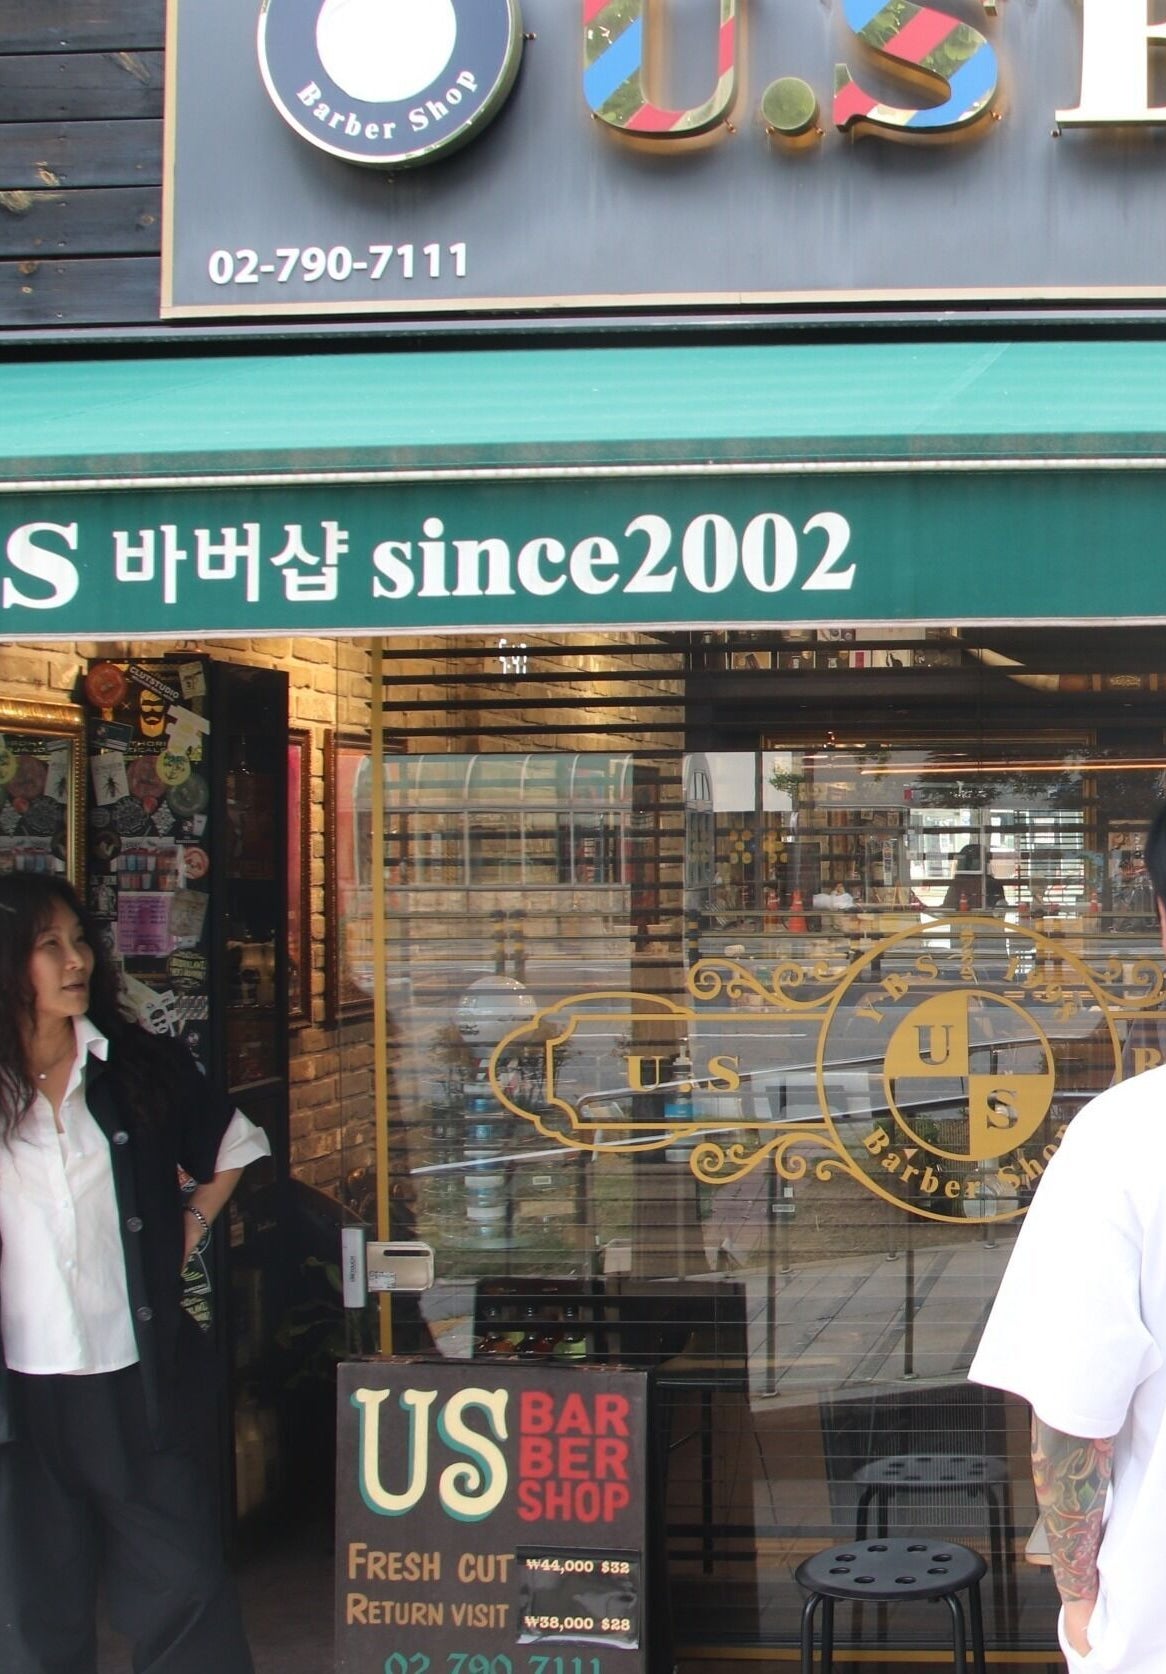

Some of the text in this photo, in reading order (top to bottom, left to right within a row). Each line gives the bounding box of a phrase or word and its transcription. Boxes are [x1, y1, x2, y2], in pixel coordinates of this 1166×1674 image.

[296, 70, 478, 140] Barber Shop
[208, 242, 467, 285] 02-790-7111
[2, 511, 857, 610] S 바버샵 since2002
[912, 1024, 955, 1066] U
[986, 1088, 1019, 1130] S
[862, 1126, 982, 1199] Barber
[520, 1390, 631, 1437] BAR
[350, 1387, 509, 1523] US
[518, 1436, 630, 1481] BER
[516, 1479, 631, 1524] SHOP
[347, 1542, 515, 1584] FRESH CUT
[600, 1559, 631, 1575] $32
[346, 1592, 510, 1629] RETURN VISIT
[600, 1616, 631, 1632] $28
[446, 1652, 513, 1674] 790
[527, 1654, 602, 1674] 7111
